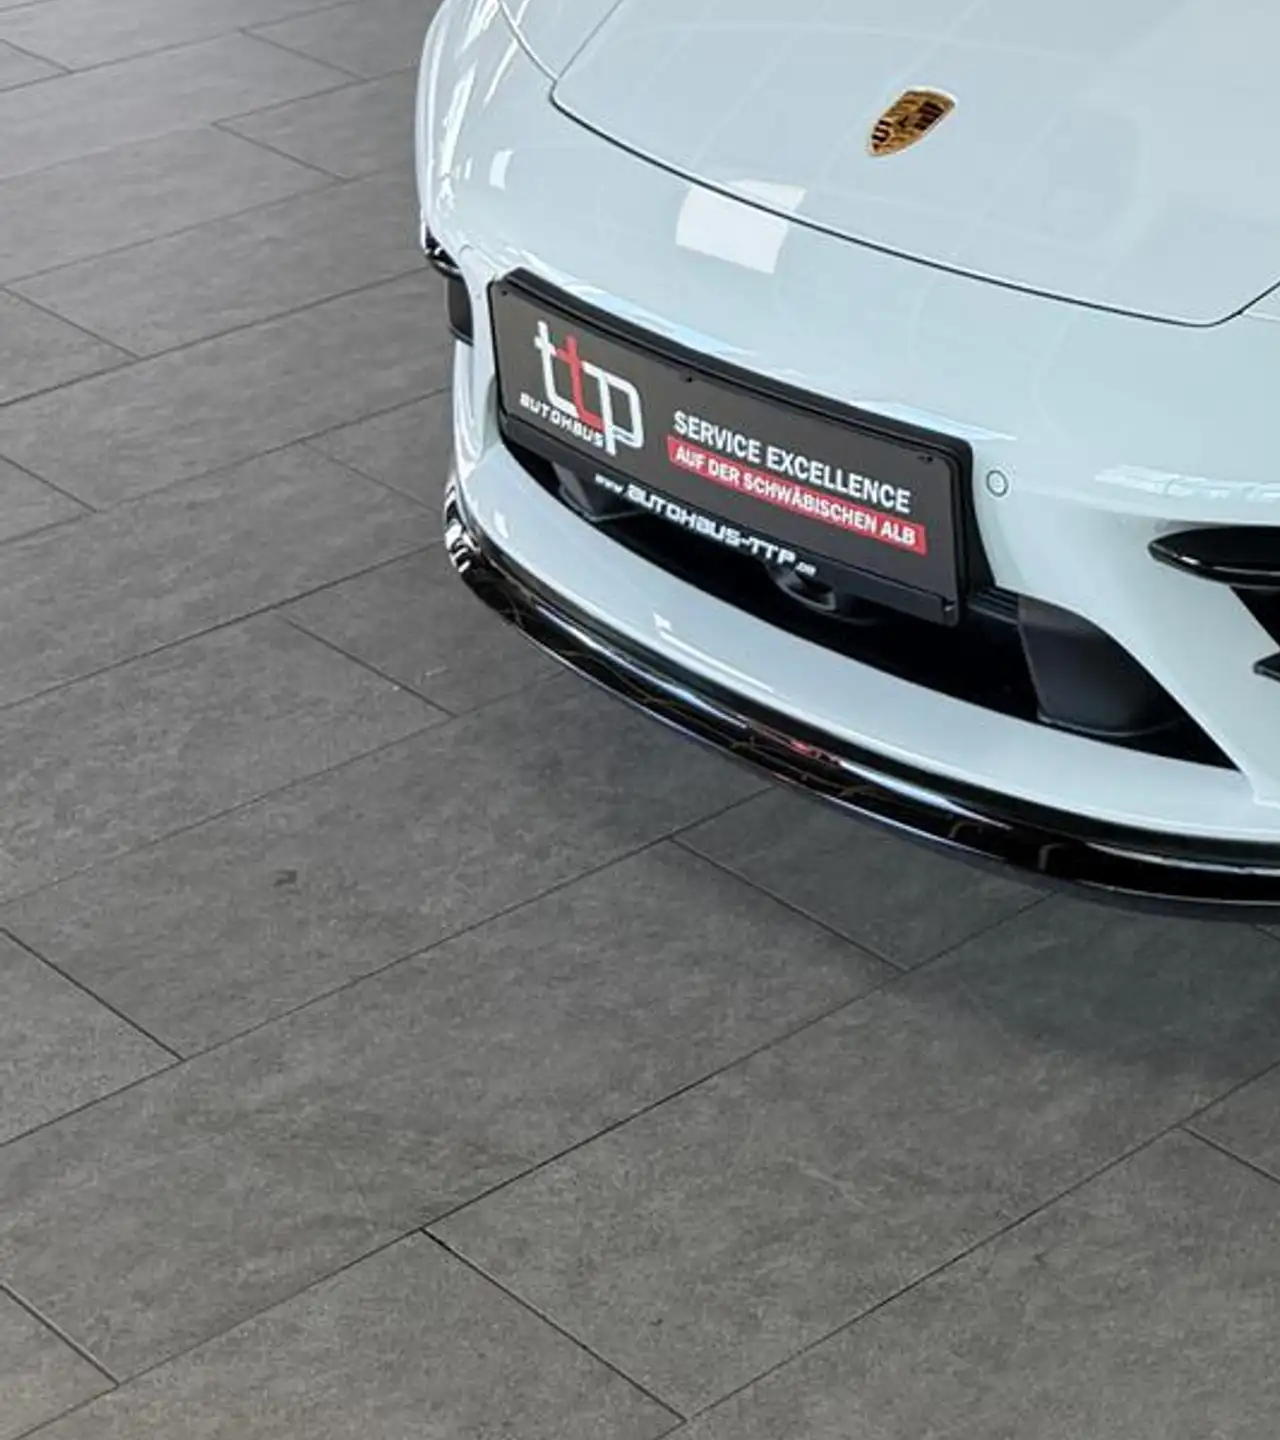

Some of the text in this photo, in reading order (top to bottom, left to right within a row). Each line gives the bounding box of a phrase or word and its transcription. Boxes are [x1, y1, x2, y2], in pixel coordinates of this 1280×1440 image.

[520, 392, 604, 448] AUTOHAUS
[674, 410, 912, 514] SERVICE EXCELLENCE
[675, 446, 705, 470] AUF
[708, 459, 740, 487] DER
[880, 521, 917, 546] ALB
